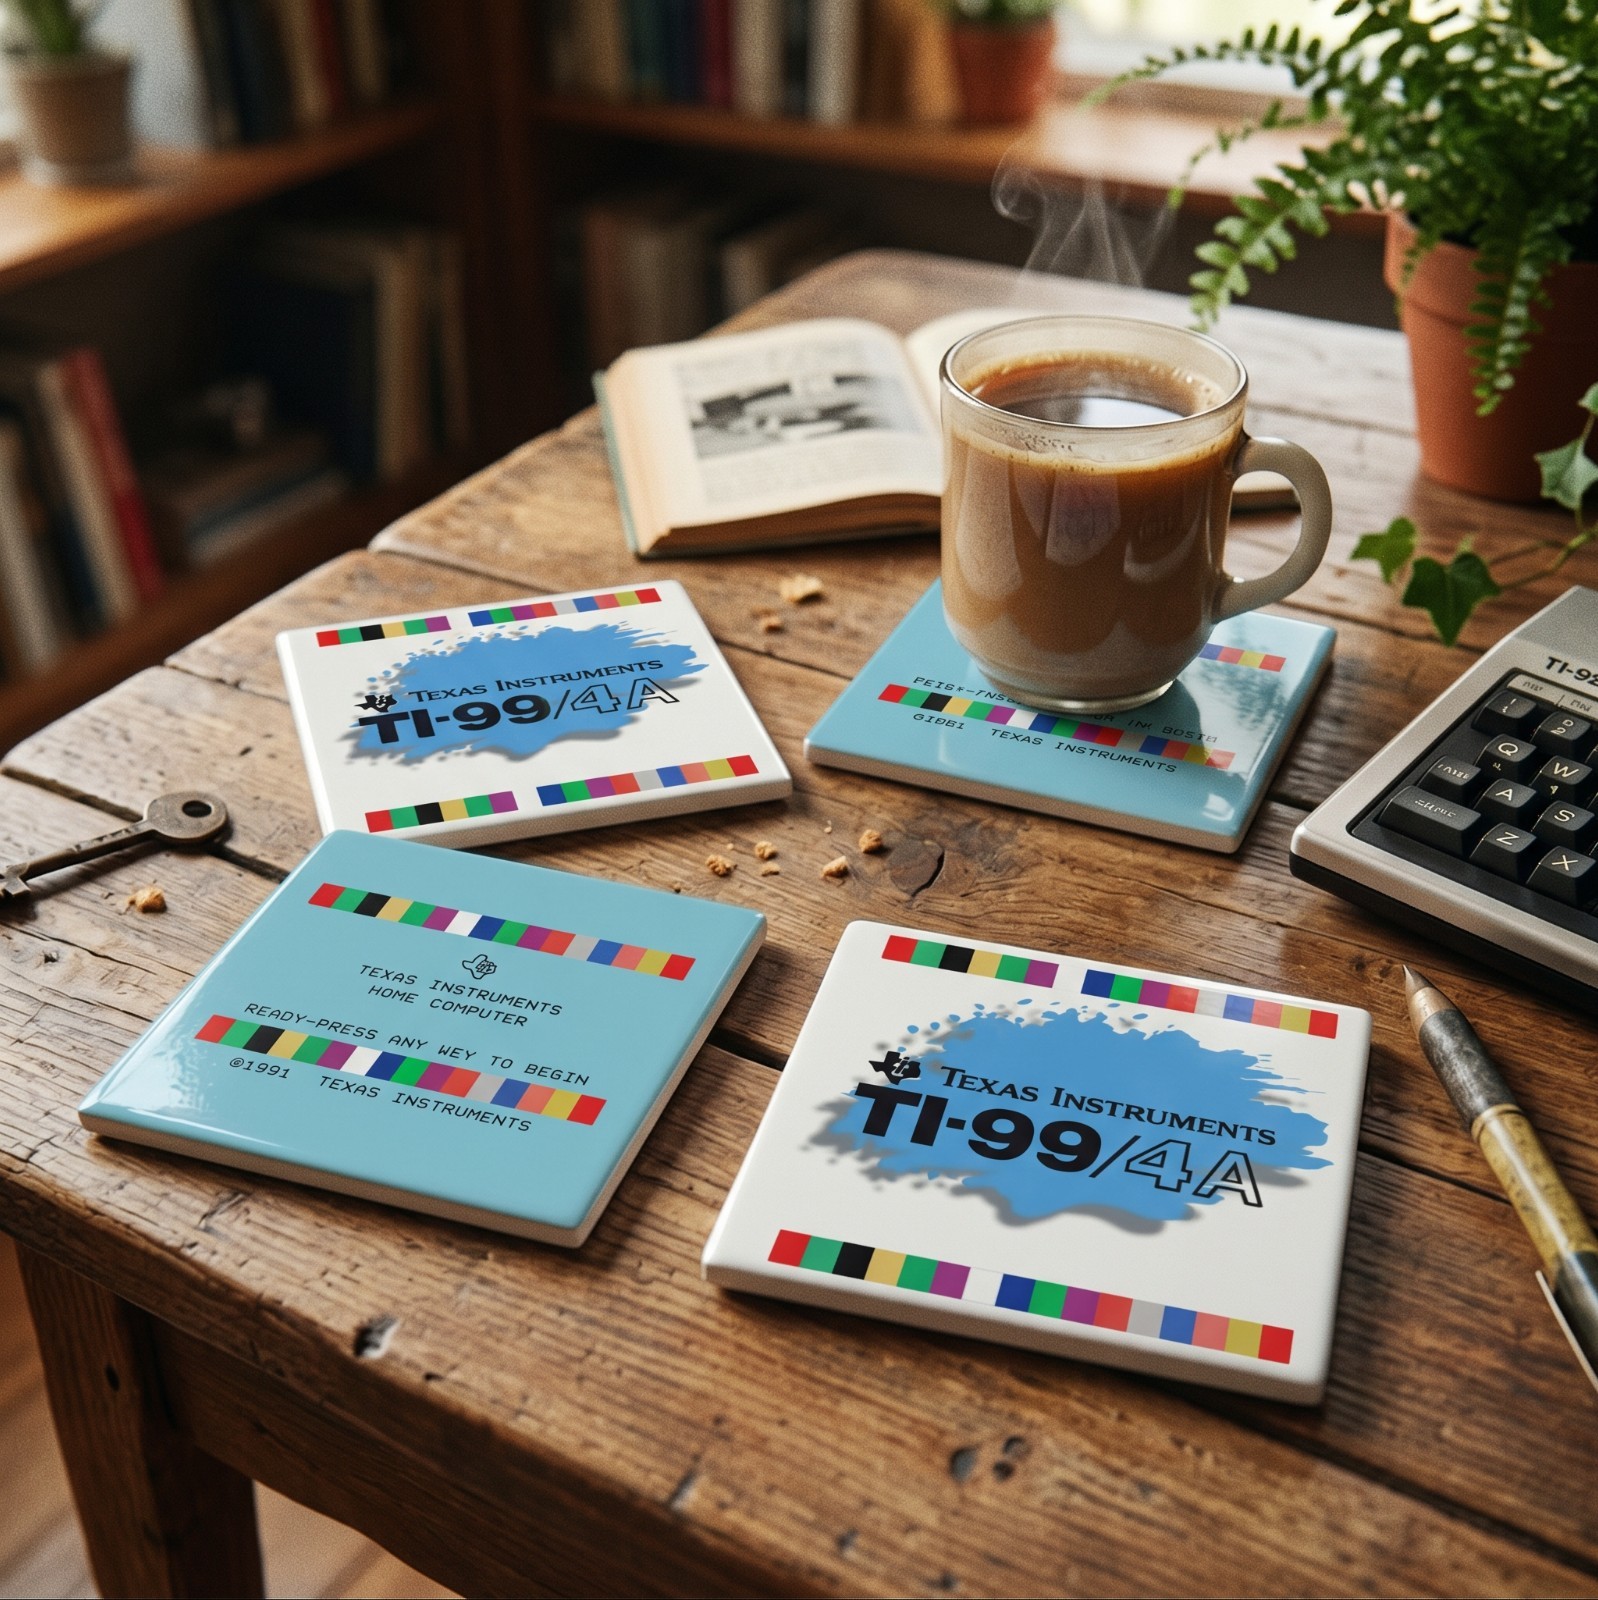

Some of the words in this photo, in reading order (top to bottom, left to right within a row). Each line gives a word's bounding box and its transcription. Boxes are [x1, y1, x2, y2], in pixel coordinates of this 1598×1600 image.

[408, 684, 487, 703] TEXAS
[496, 660, 664, 693] INSTRUMENTS
[358, 677, 680, 744] TI-99/4A
[991, 728, 1044, 746] TEXAS
[1055, 741, 1177, 773] INSTRUMENTS
[1498, 742, 1518, 757] Q
[1553, 762, 1580, 778] W
[1495, 788, 1515, 802] A
[1554, 809, 1576, 822] S
[1496, 831, 1520, 846] Z
[1551, 854, 1579, 871] X
[360, 964, 418, 985] TEXAS
[429, 979, 563, 1016] INSTRUMENTS
[368, 985, 419, 1004] HOME
[429, 998, 528, 1027] COMPUTER
[244, 1003, 379, 1040] READY-PRESS
[388, 1035, 428, 1050] ANY
[438, 1044, 477, 1061] WEY
[491, 1055, 513, 1069] TO
[524, 1063, 590, 1086] BEGIN
[229, 1057, 290, 1079] ©1991
[319, 1075, 381, 1098] TEXAS
[392, 1092, 532, 1132] INSTRUMENTS
[940, 1065, 1040, 1102] TEXAS
[1050, 1086, 1276, 1146] INSTRUMENTS
[854, 1082, 1263, 1208] TI-99/4A
